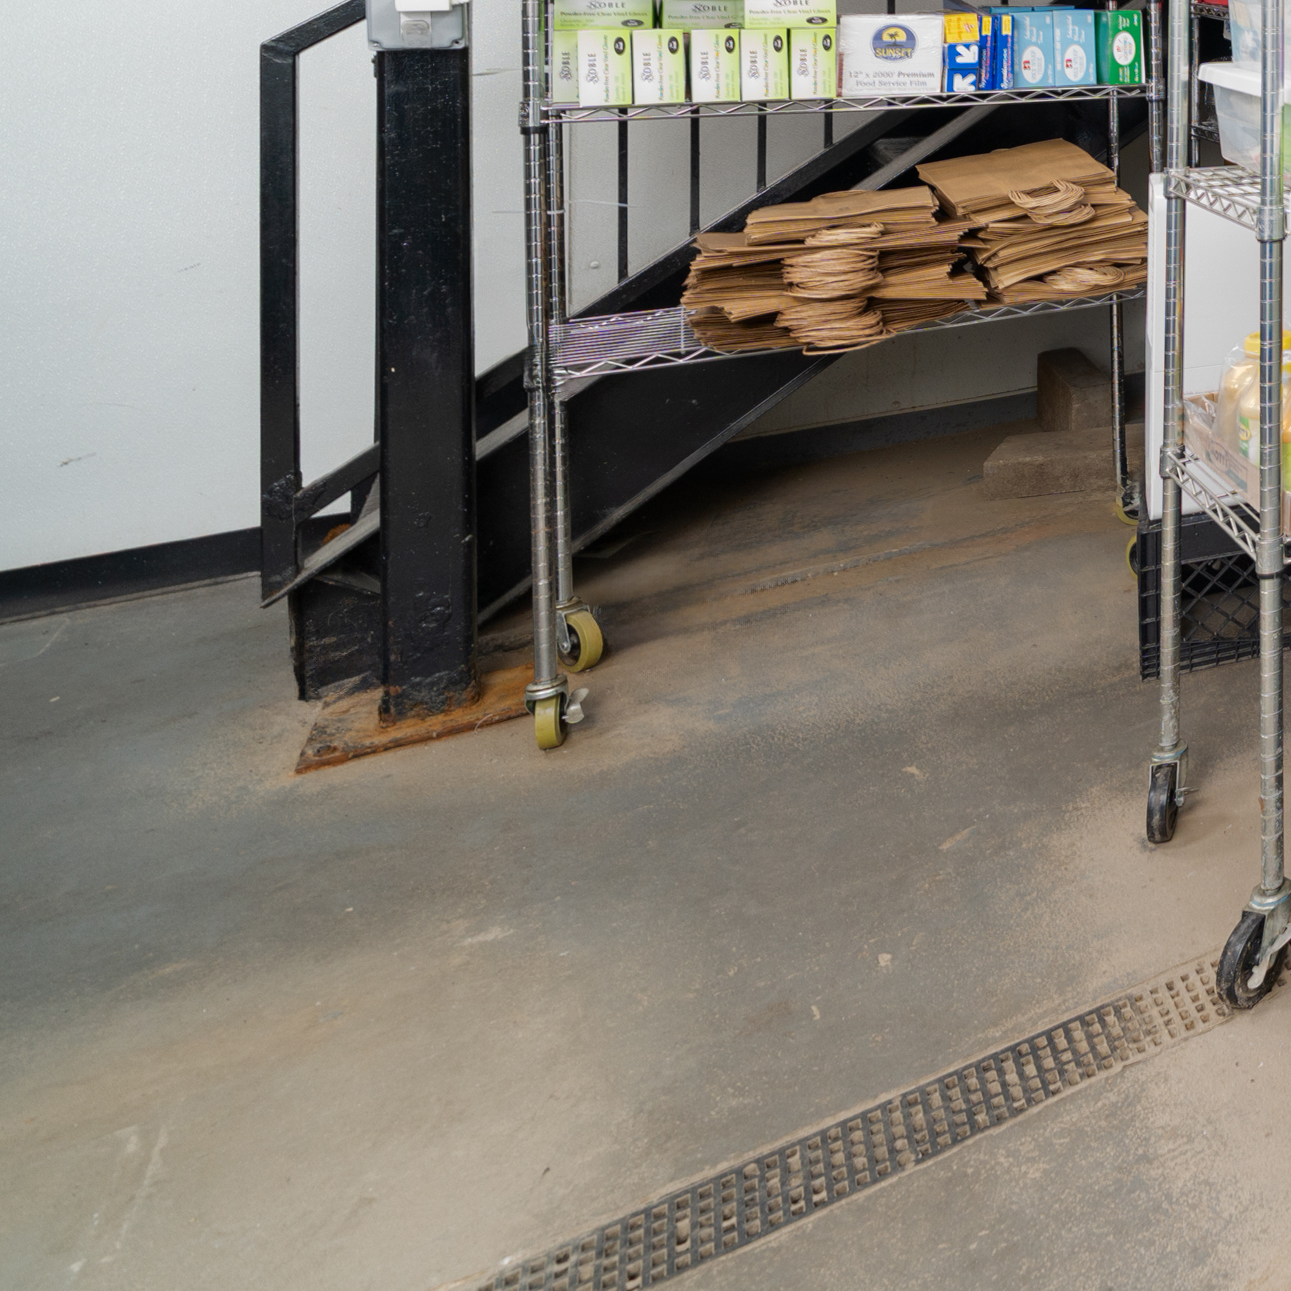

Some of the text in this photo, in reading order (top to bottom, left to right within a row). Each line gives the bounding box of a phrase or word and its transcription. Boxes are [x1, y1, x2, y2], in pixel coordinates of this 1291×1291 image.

[587, 0, 627, 11] NOBLE
[691, 2, 729, 13] NOBLE
[559, 51, 574, 82] NOBLE
[698, 51, 711, 81] NOBLE
[747, 50, 760, 79] NOBLE
[796, 48, 809, 77] NOBLE
[875, 47, 913, 57] SUNSET
[585, 53, 599, 84] NOBLE
[641, 52, 654, 82] NOBLE
[897, 71, 936, 79] Premium
[855, 79, 928, 87] Food Service Film
